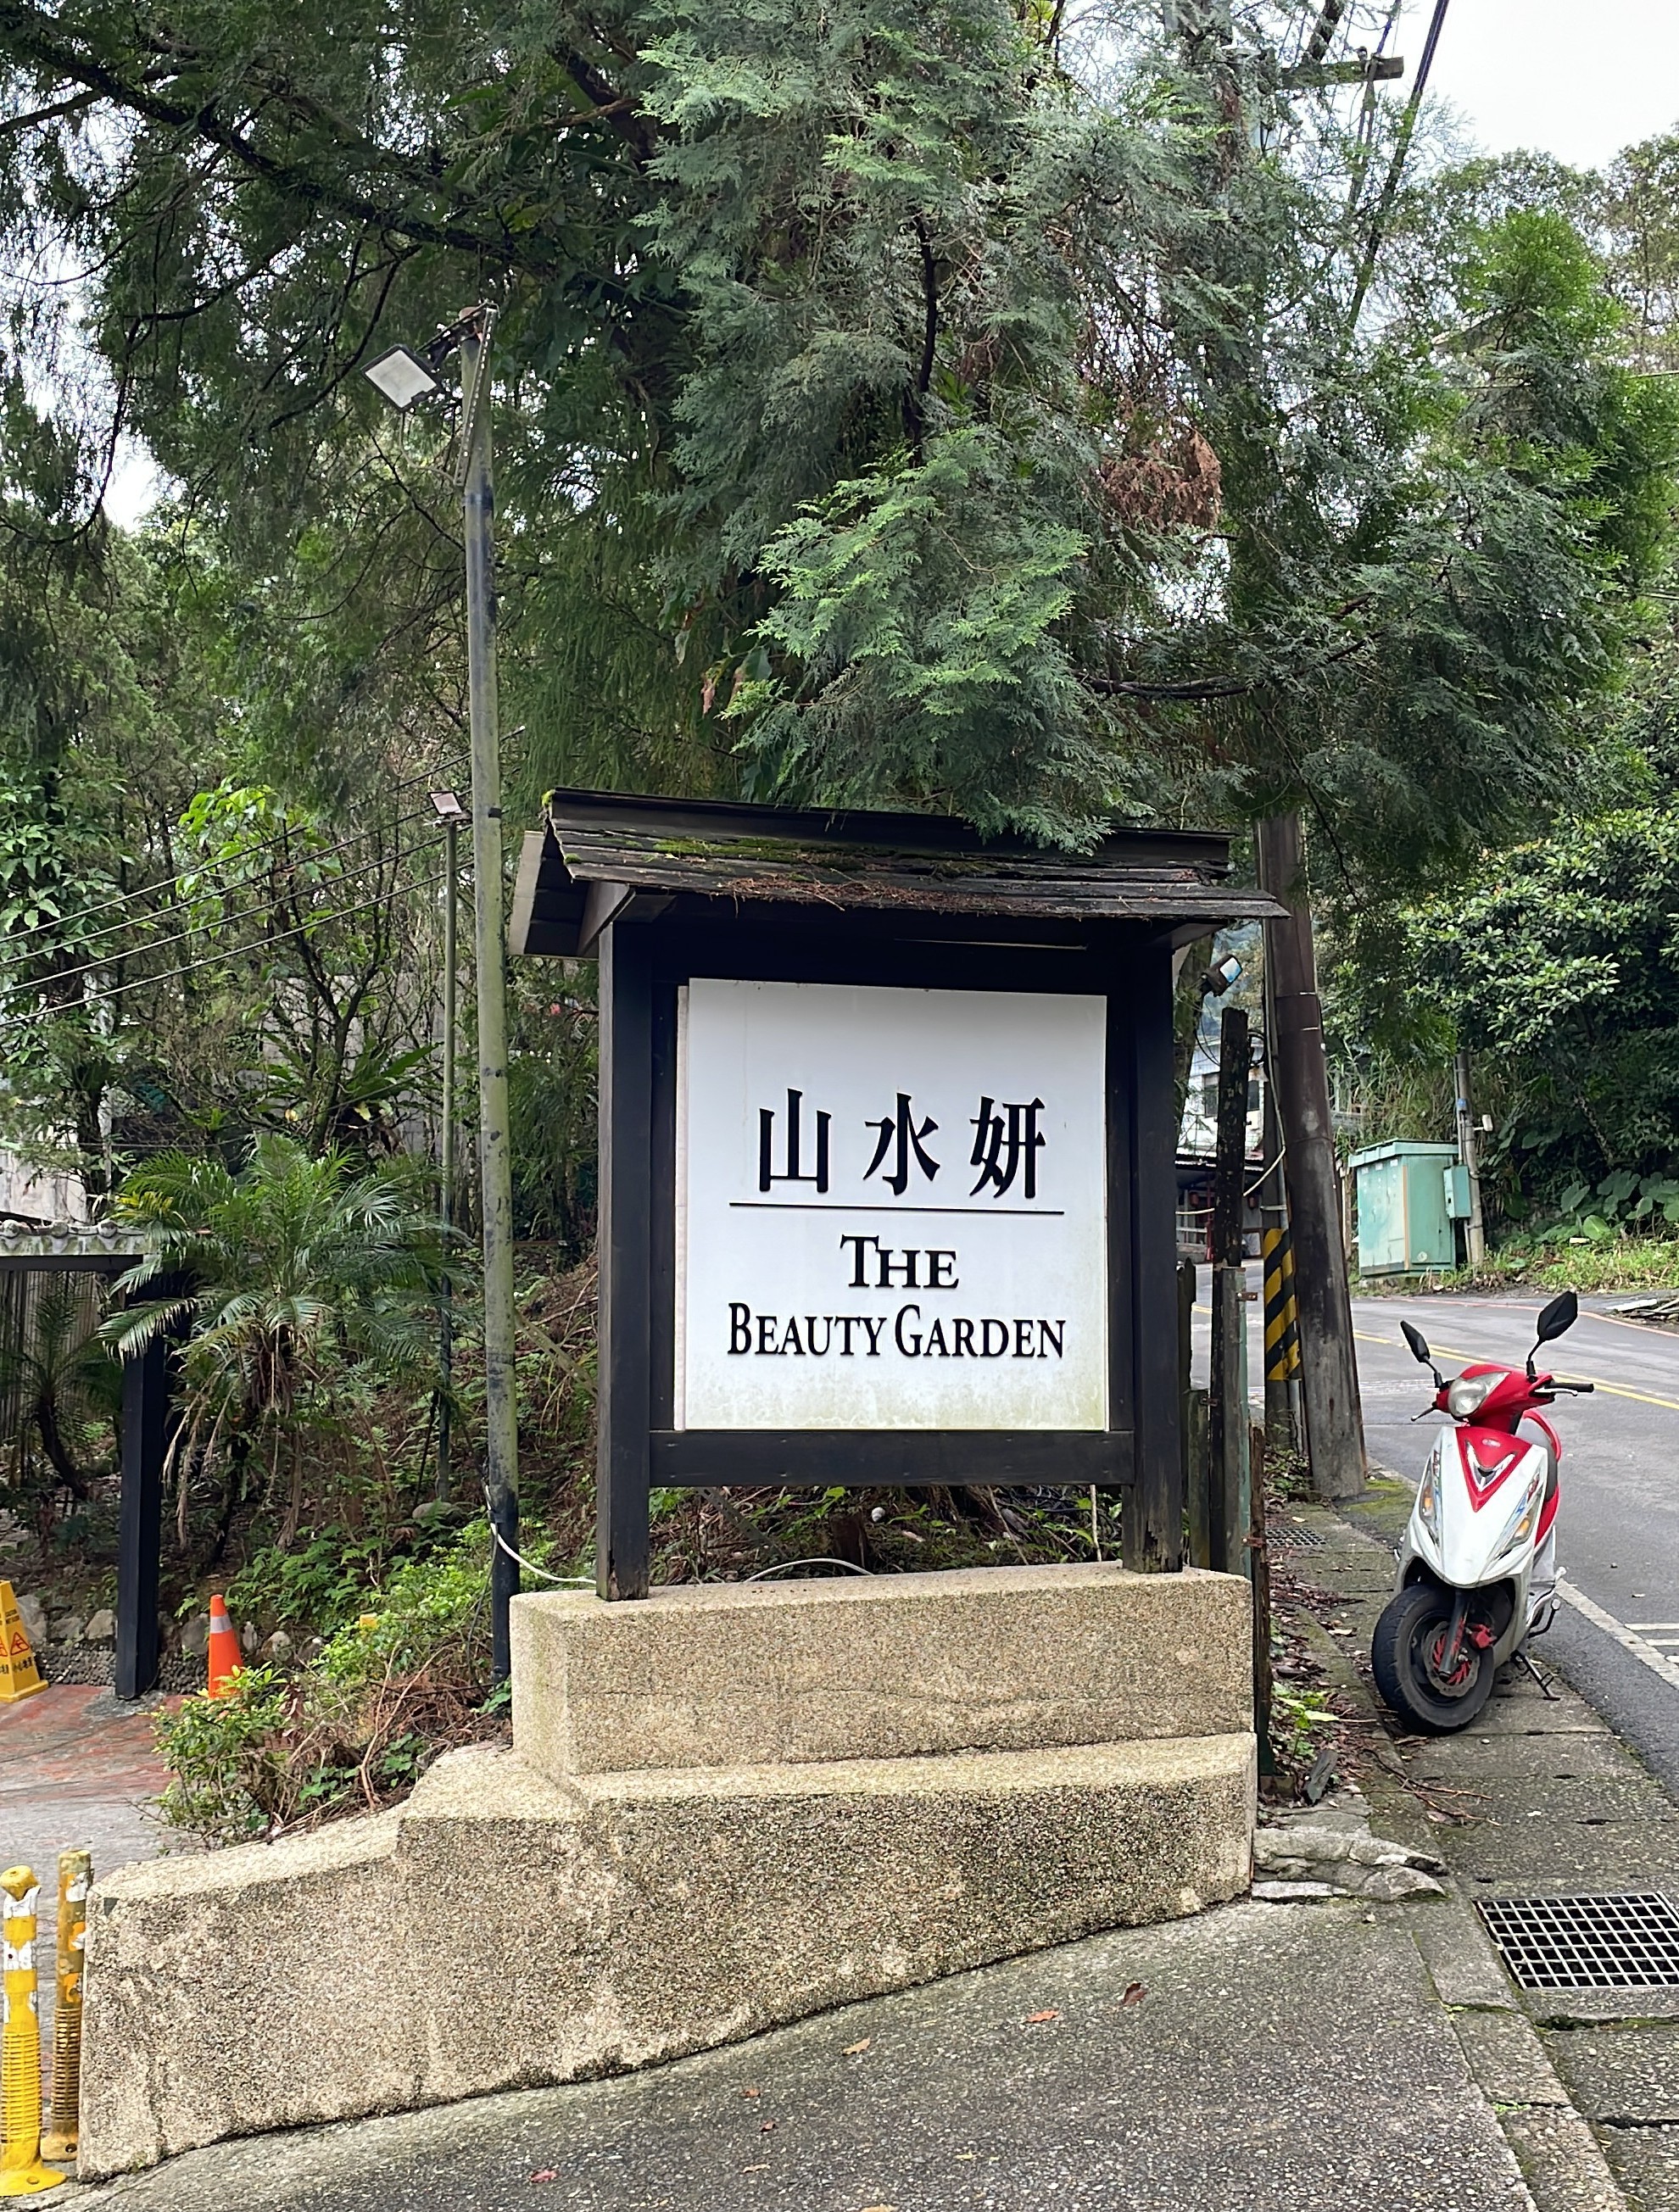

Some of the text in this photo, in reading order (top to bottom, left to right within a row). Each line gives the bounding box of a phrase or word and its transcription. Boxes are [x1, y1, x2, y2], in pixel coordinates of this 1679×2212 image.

[759, 1088, 1046, 1199] 山水妍
[840, 1234, 960, 1290] THE
[727, 1302, 1066, 1359] BEAUTY GARDEN
